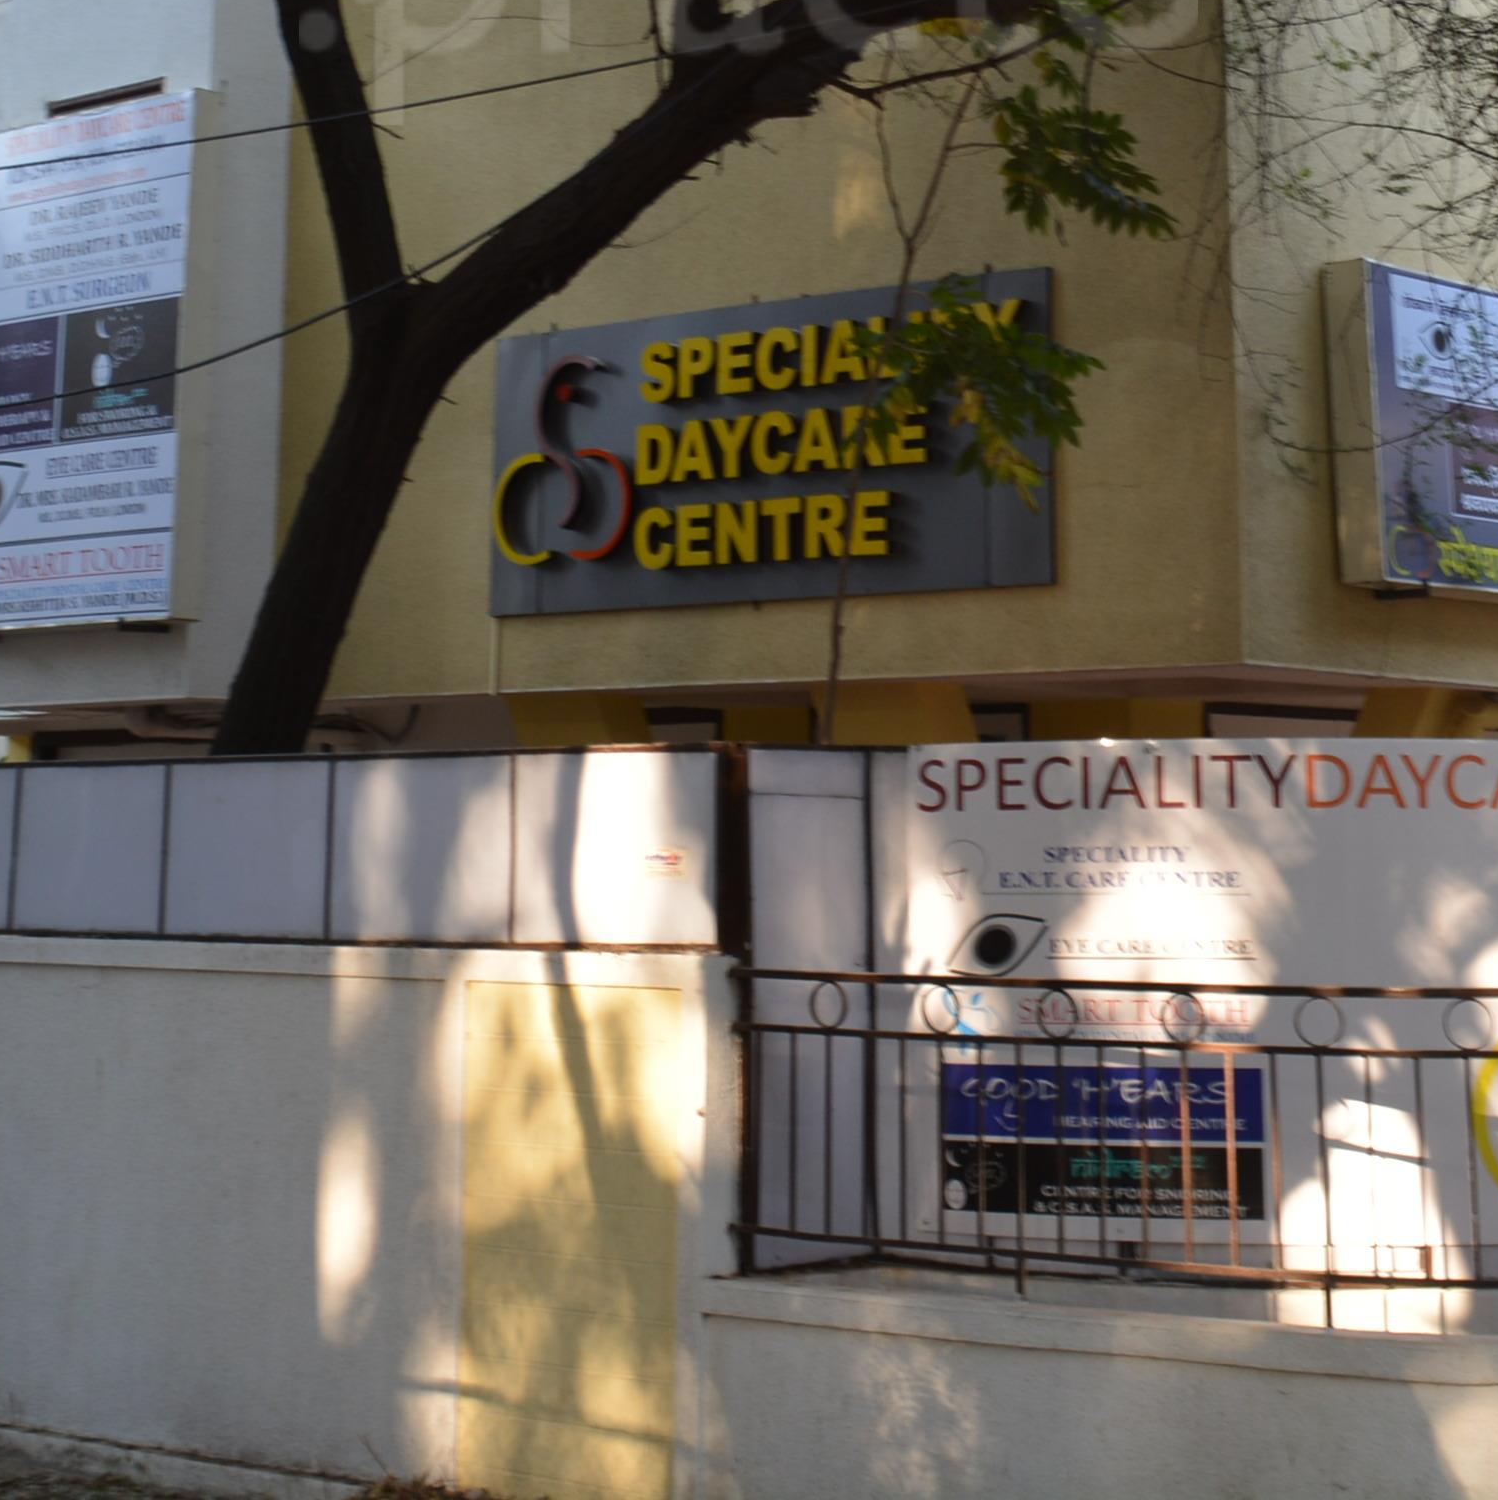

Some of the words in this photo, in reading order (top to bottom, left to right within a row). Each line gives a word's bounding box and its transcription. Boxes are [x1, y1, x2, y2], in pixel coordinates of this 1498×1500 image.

[640, 299, 1023, 403] SPECIALY
[635, 404, 928, 486] DAYCARE
[106, 446, 159, 469] CENTRE
[633, 490, 890, 571] CENTRE
[79, 543, 165, 573] TOOTH
[917, 755, 1297, 812] SPECIALITY
[1043, 846, 1188, 864] SPECIALITY
[1065, 871, 1127, 889] CARE
[1051, 939, 1091, 954] EYE
[1097, 939, 1154, 954] CARE
[1162, 939, 1253, 955] CNTRE
[1019, 998, 1121, 1022] SMART
[1134, 999, 1251, 1024] TOOTH
[1053, 1115, 1133, 1129] HEARNG
[1172, 1118, 1248, 1132] CENTE
[1155, 1189, 1238, 1203] SNRIN
[1116, 1203, 1250, 1218] MANAGMENT
